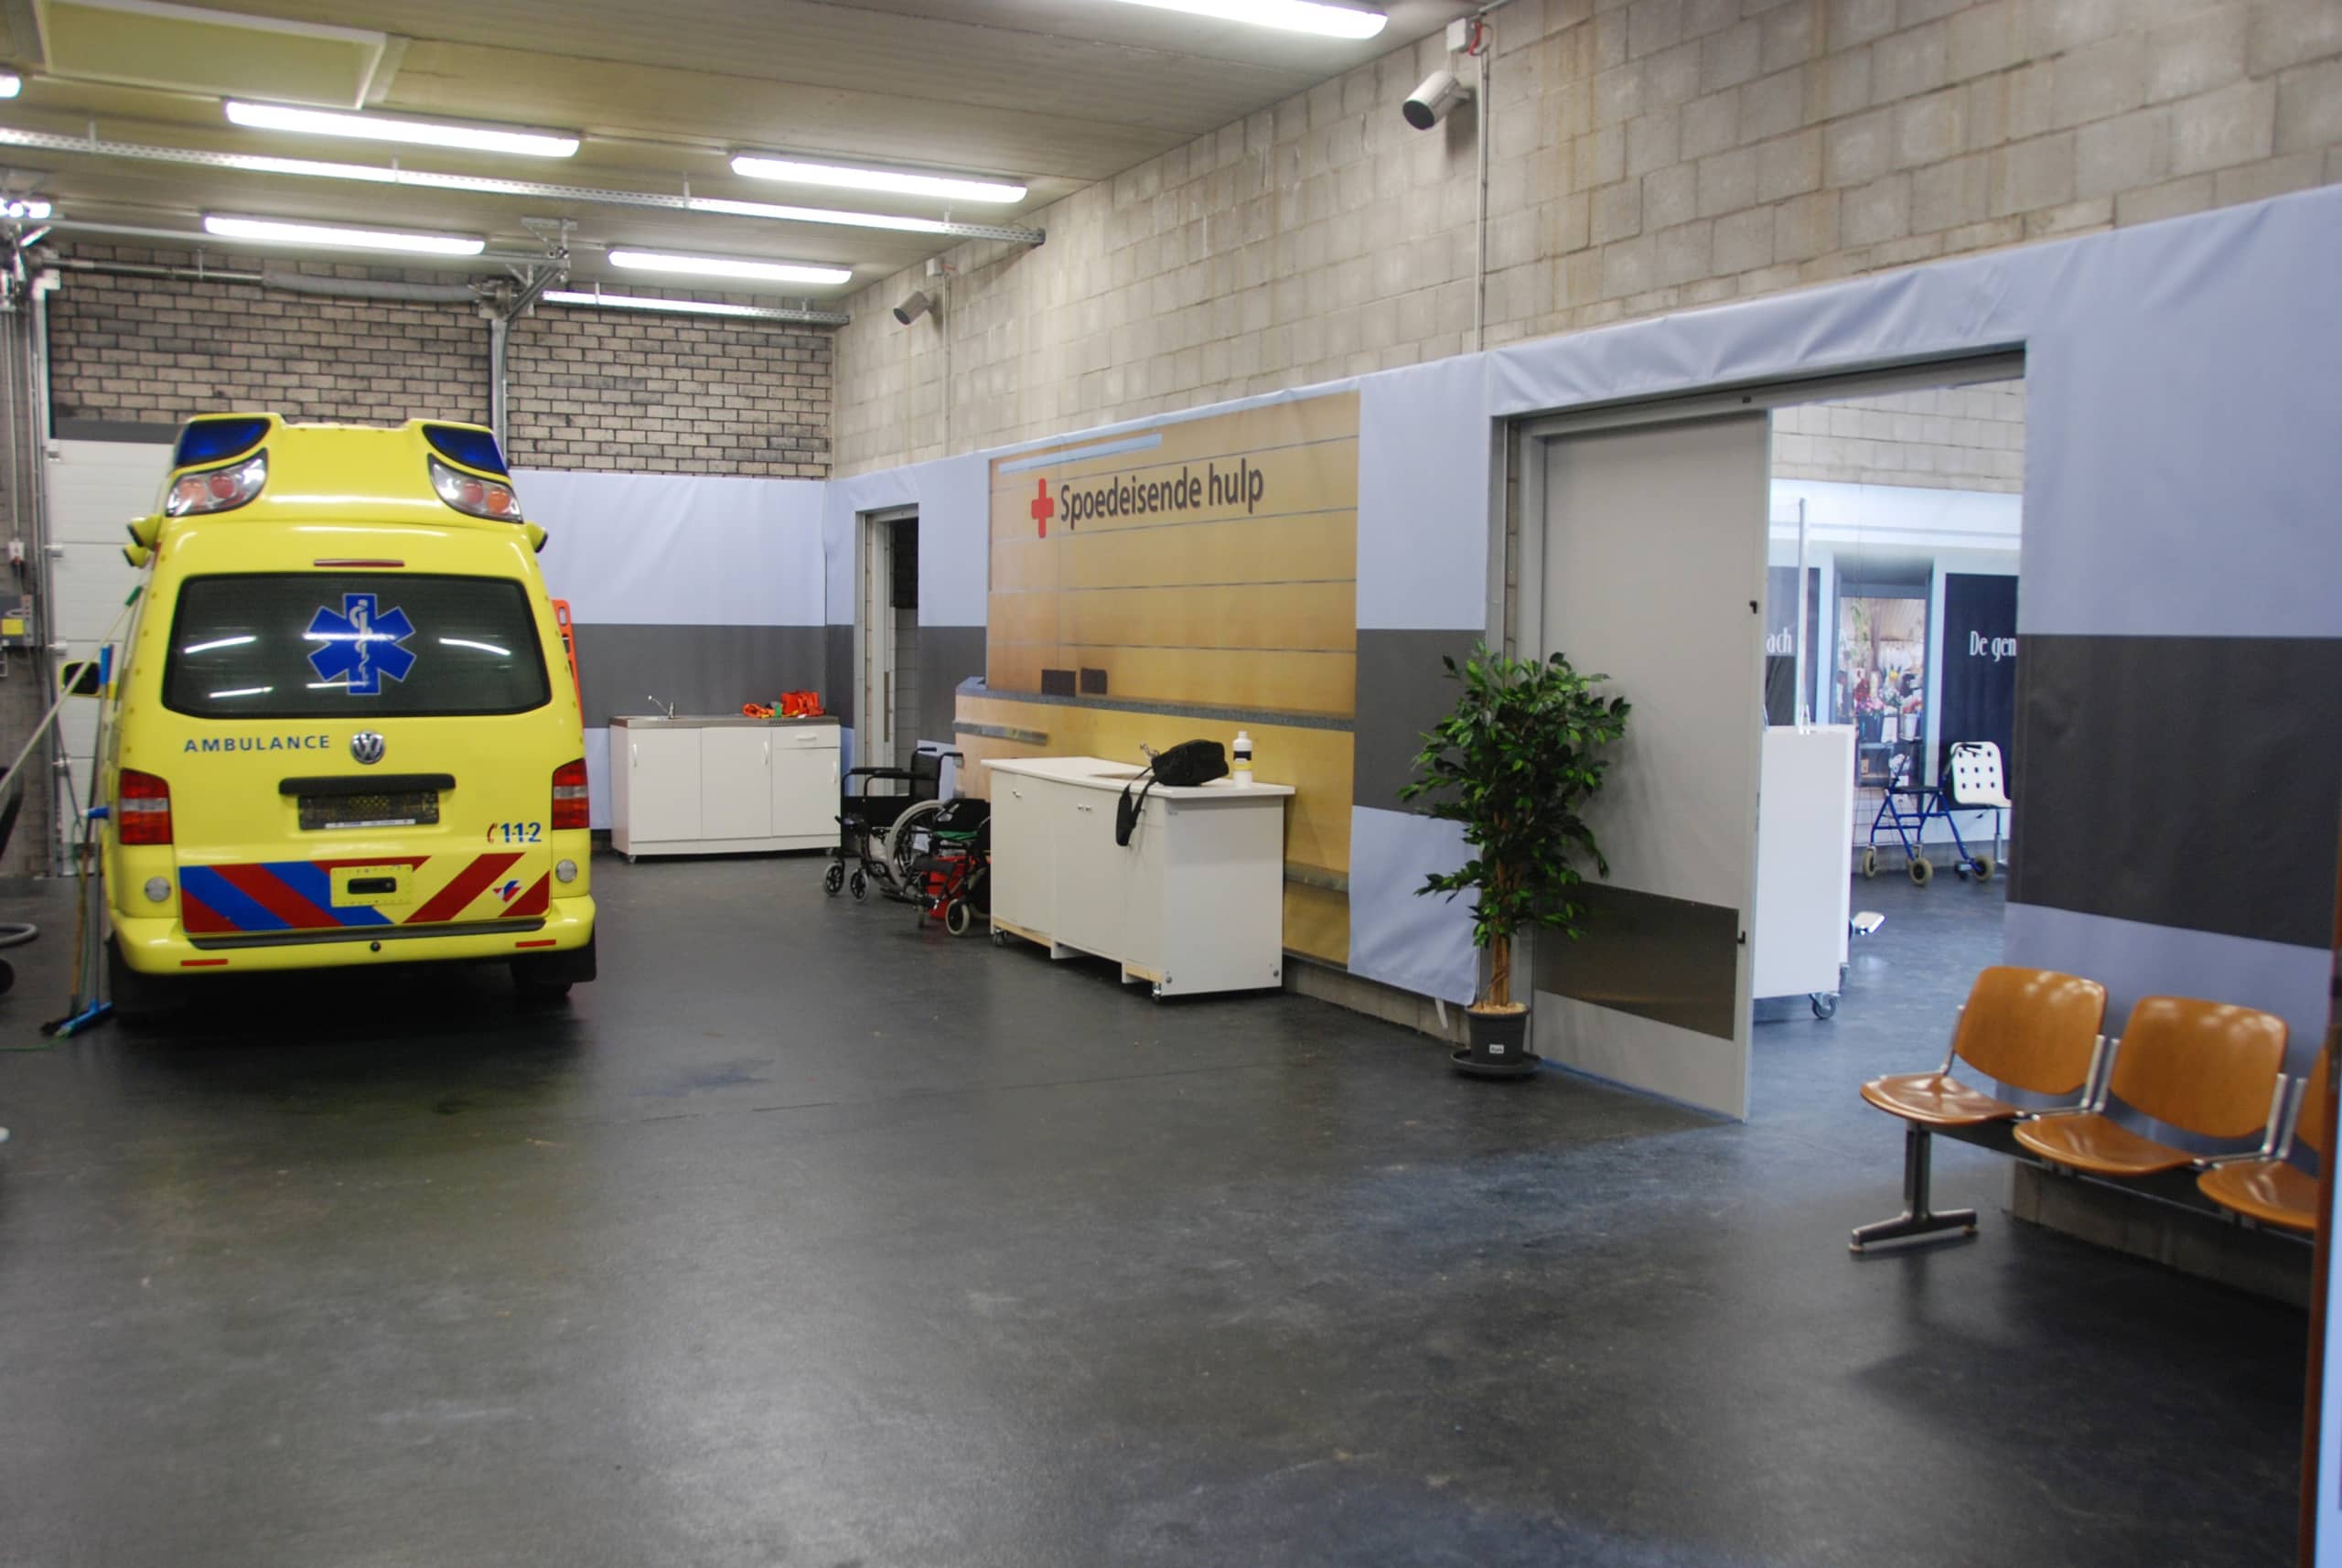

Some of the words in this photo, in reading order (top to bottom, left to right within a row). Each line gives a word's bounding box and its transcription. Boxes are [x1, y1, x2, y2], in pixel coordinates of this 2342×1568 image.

[1060, 466, 1202, 531] Spoedeisende
[1209, 457, 1264, 514] hulp
[1970, 630, 1988, 656] De
[184, 735, 330, 753] AMBULANCE
